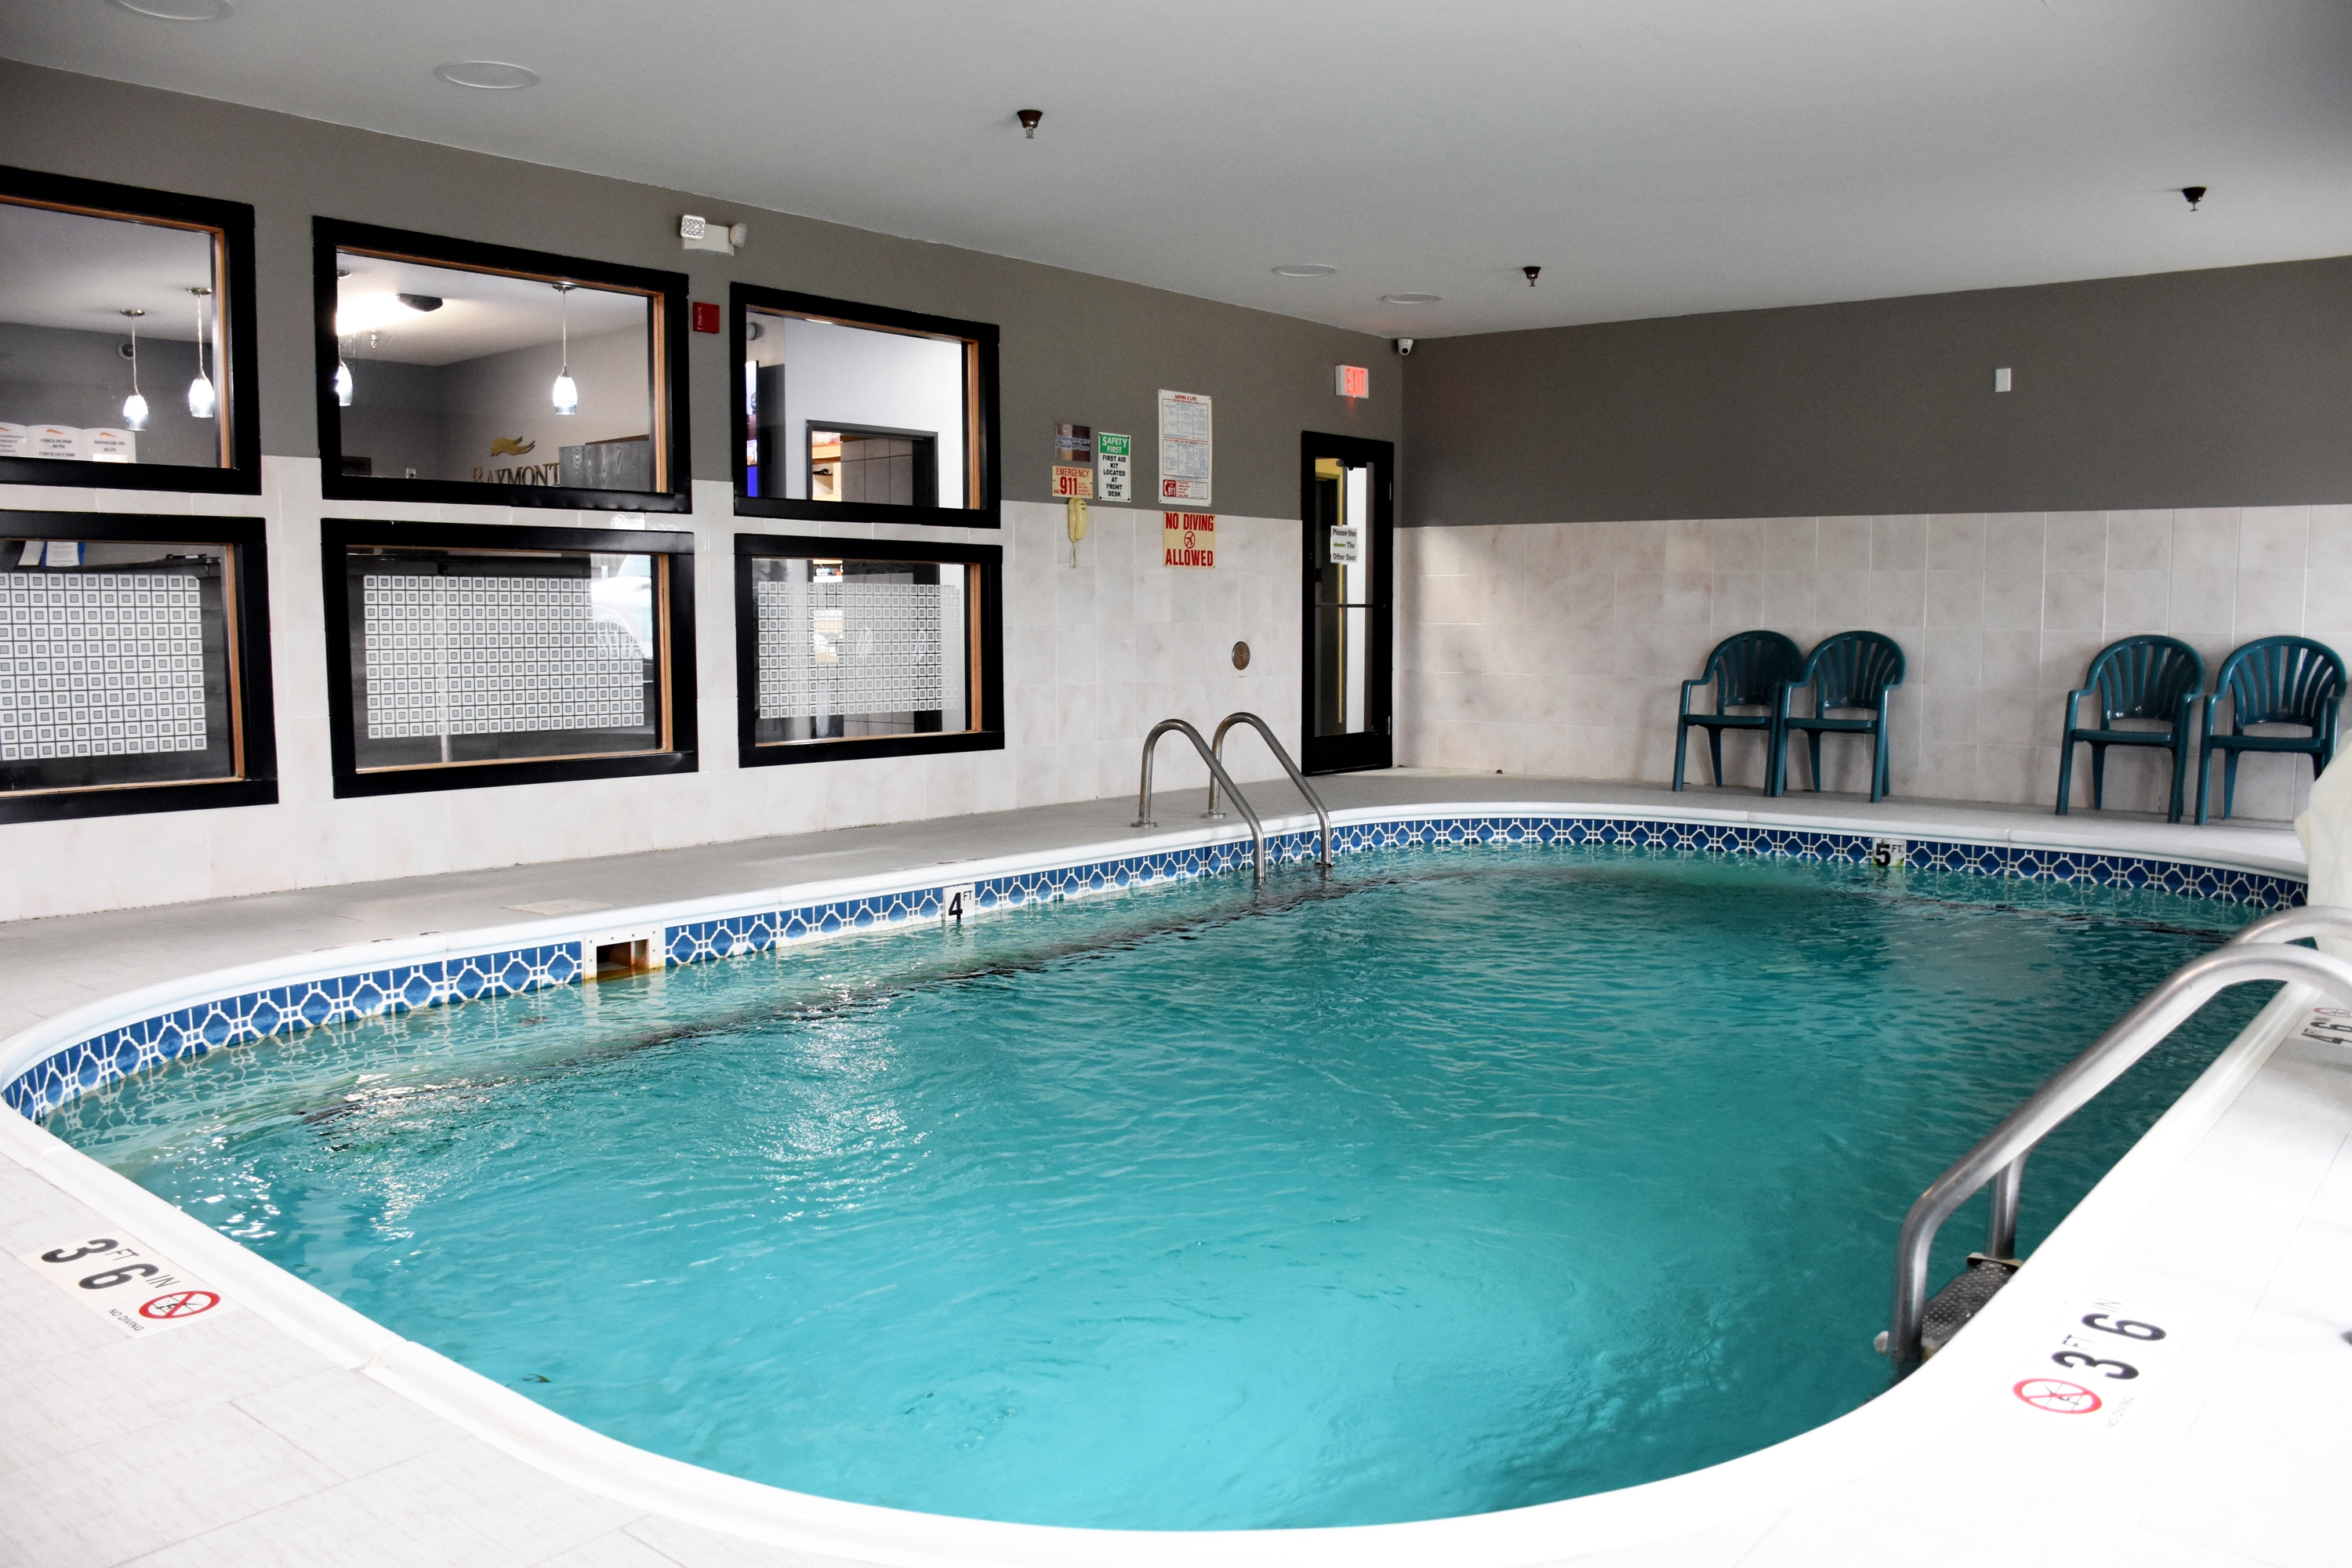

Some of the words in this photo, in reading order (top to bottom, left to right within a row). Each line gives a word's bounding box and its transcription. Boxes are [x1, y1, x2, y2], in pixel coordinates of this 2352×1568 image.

[1346, 367, 1366, 395] EXIT
[1102, 437, 1127, 448] SAFETY
[1056, 467, 1089, 477] EMERGENCY
[1060, 476, 1077, 495] 911
[1167, 486, 1176, 496] 911
[1166, 512, 1179, 530] NO
[1183, 514, 1214, 532] DIVING
[1333, 528, 1347, 536] Please
[1166, 548, 1214, 567] ALLOWED
[1876, 844, 1890, 866] 5
[1892, 844, 1902, 853] FT
[949, 892, 963, 920] 4
[964, 891, 973, 901] FT
[41, 1238, 119, 1263] 3
[105, 1248, 140, 1261] FT
[78, 1263, 159, 1290] 6
[145, 1274, 181, 1288] IN
[2090, 1298, 2123, 1312] IN
[118, 1316, 144, 1331] DIVING
[2081, 1312, 2167, 1341] 6
[2061, 1334, 2094, 1351] FT
[2051, 1350, 2140, 1380] 3
[2104, 1417, 2119, 1428] NO
[2112, 1396, 2134, 1417] DIVING
